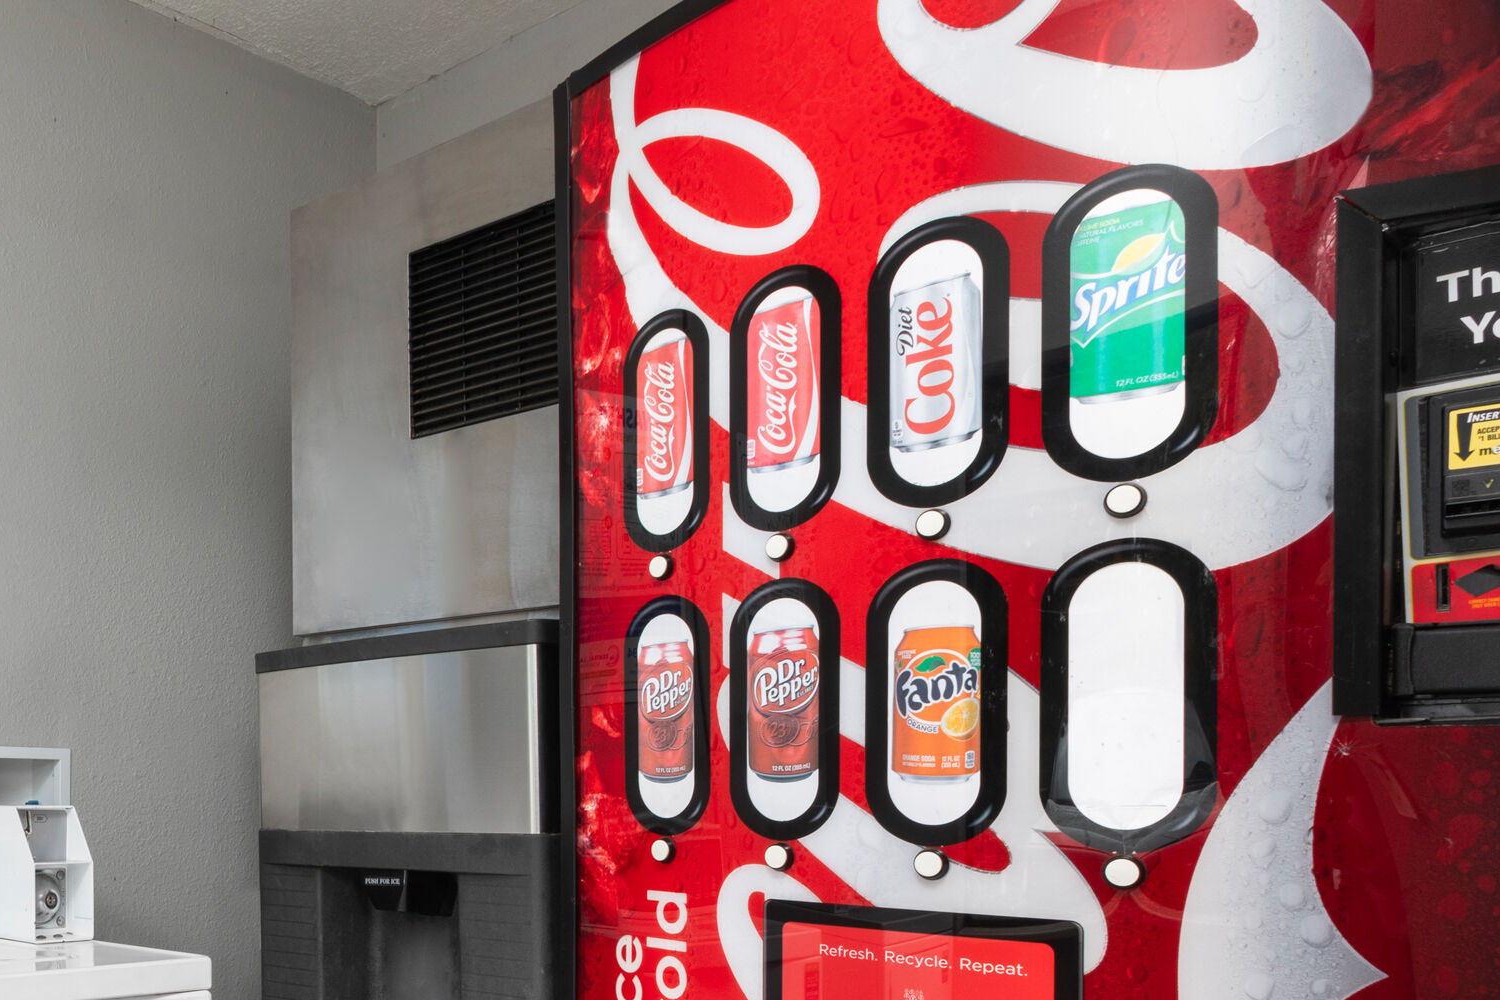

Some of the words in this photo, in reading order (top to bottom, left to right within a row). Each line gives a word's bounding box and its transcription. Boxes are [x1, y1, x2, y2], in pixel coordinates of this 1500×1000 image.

[1070, 245, 1185, 332] Sprite
[896, 306, 914, 356] Diet
[757, 321, 798, 454] Coca-Cola
[904, 296, 956, 435] Coke
[644, 360, 675, 482] Coca-Cola
[642, 676, 692, 714] Pepper
[660, 670, 682, 692] Dr
[753, 664, 818, 707] Pepper
[776, 659, 805, 688] Dr
[896, 662, 978, 717] Fanta
[907, 718, 938, 733] ORANGE
[819, 944, 878, 962] Refresh.
[884, 951, 952, 969] Recycle.
[959, 957, 1028, 977] Repeat.
